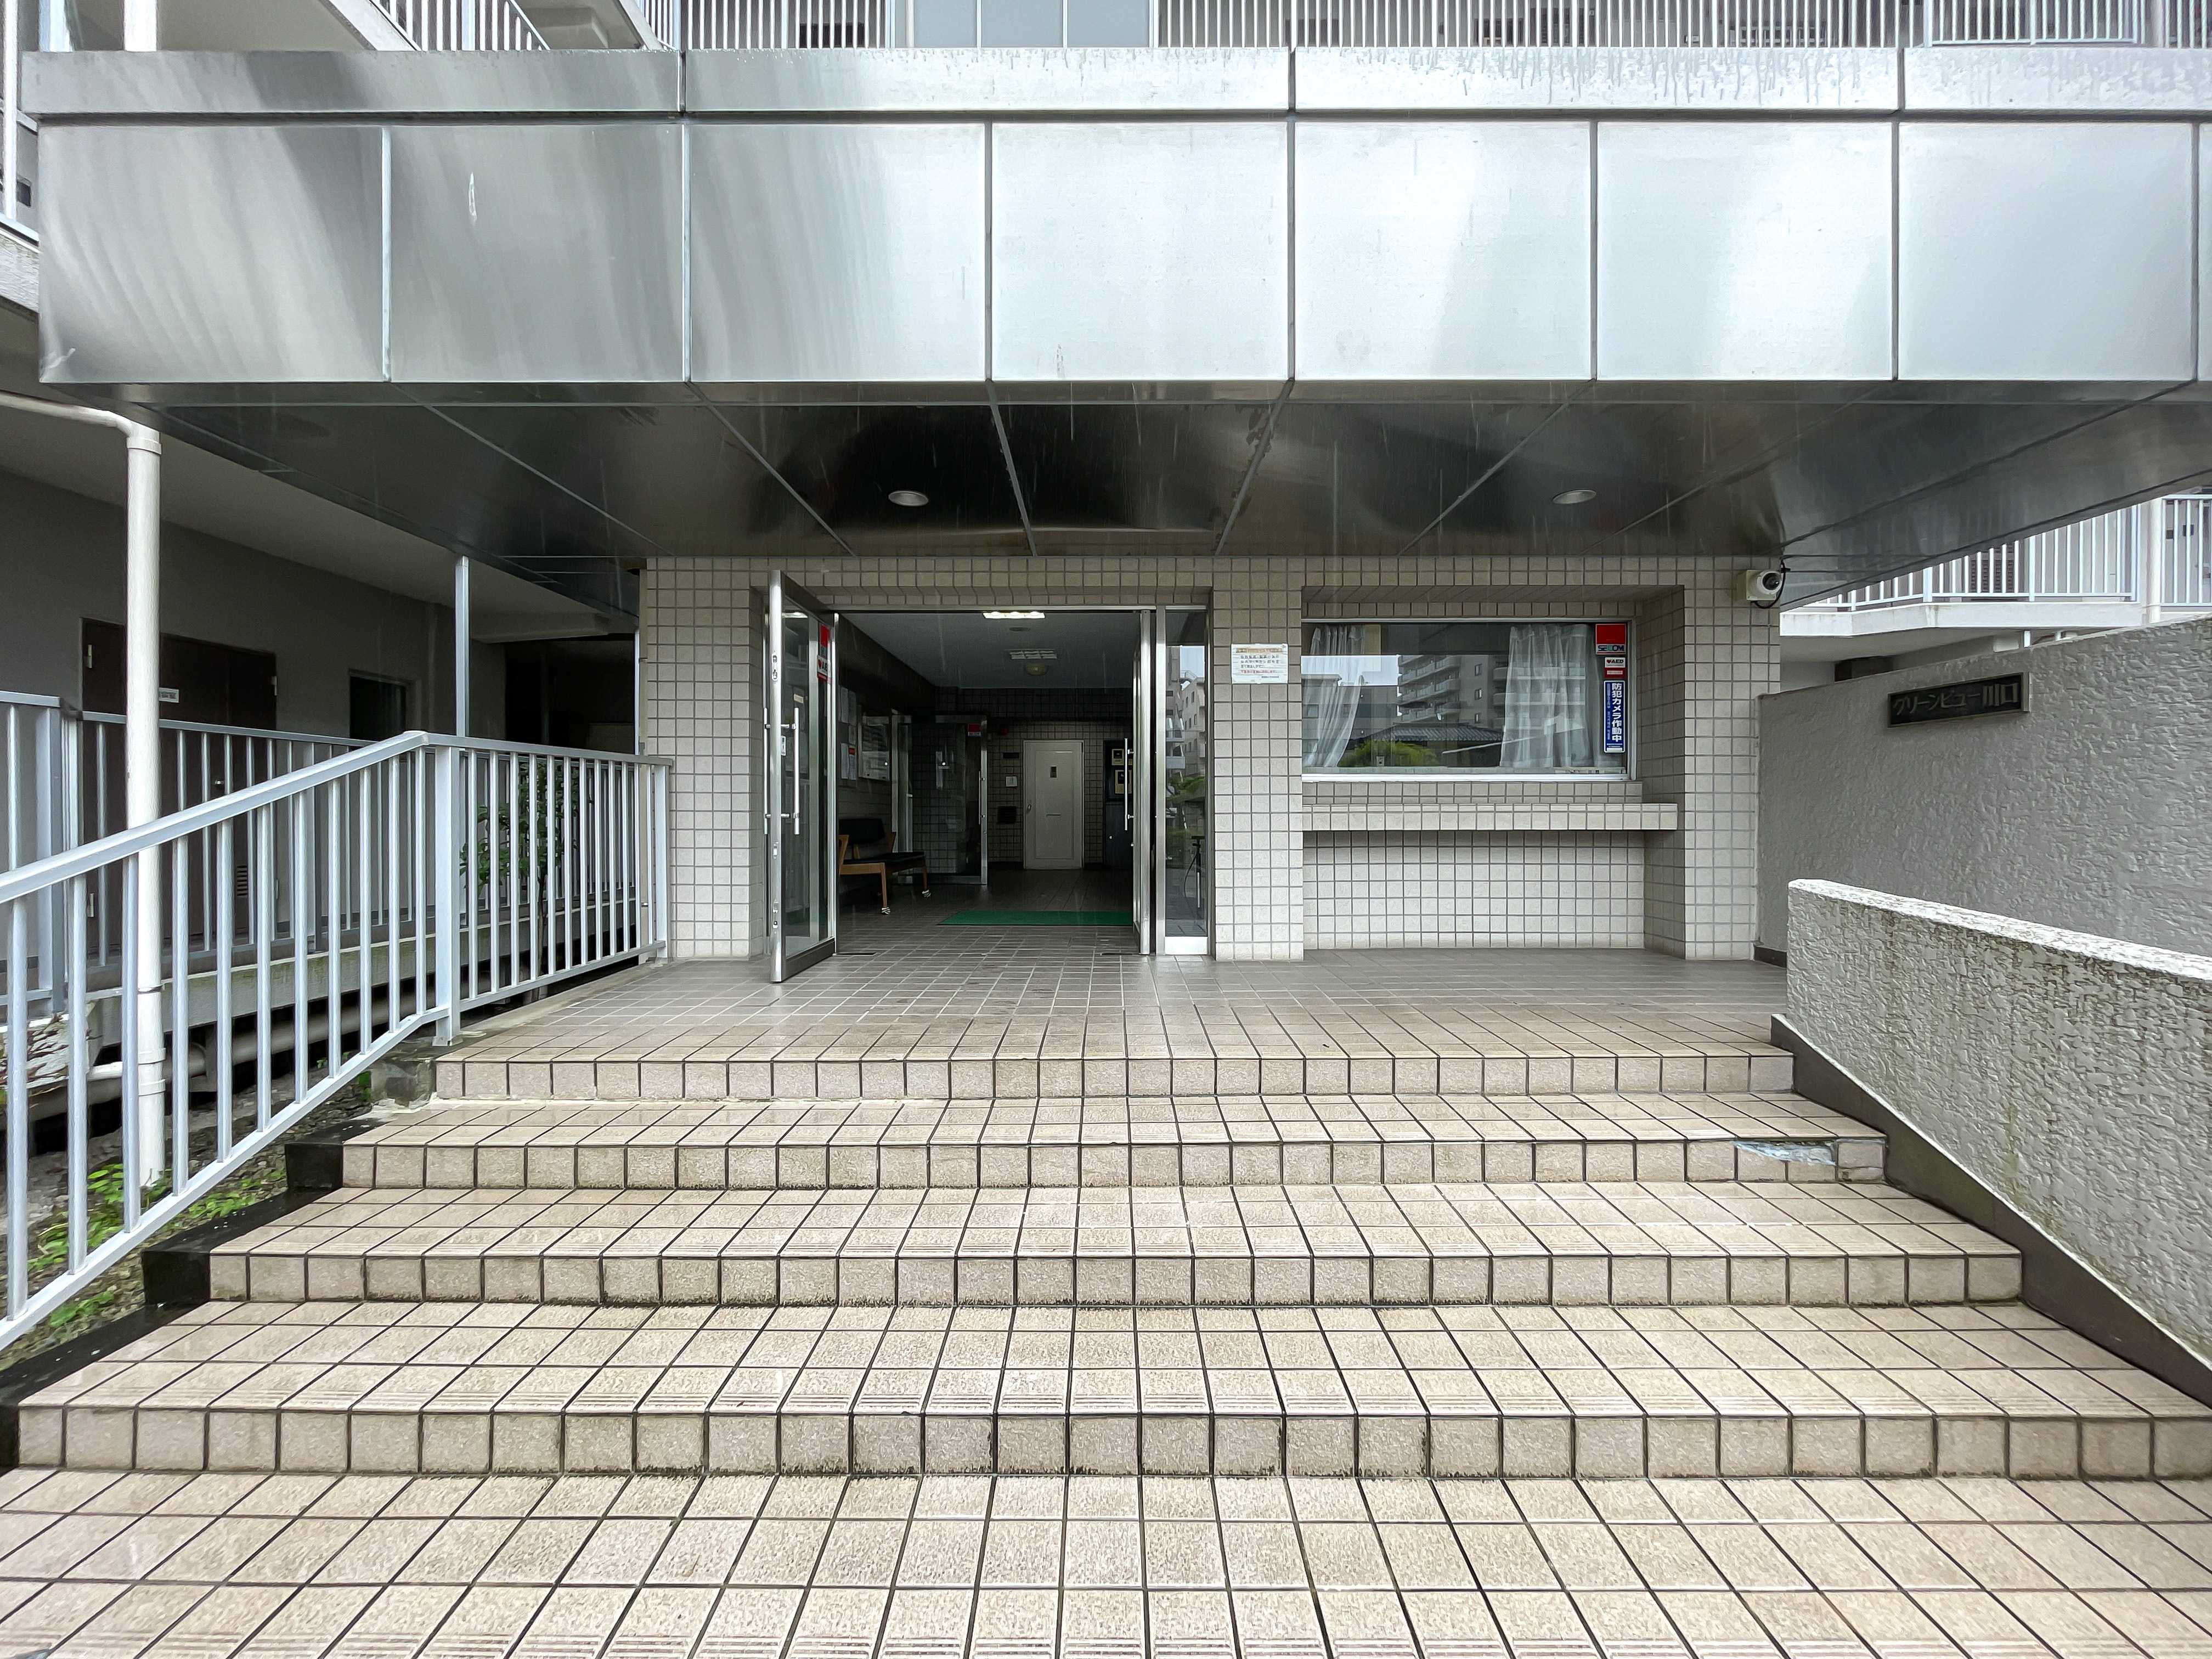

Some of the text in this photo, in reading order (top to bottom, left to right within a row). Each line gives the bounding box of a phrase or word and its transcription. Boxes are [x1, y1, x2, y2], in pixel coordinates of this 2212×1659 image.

[1611, 683, 1622, 742] 防犯カメラ作動中
[1893, 682, 2019, 715] グリーンビュー川口
